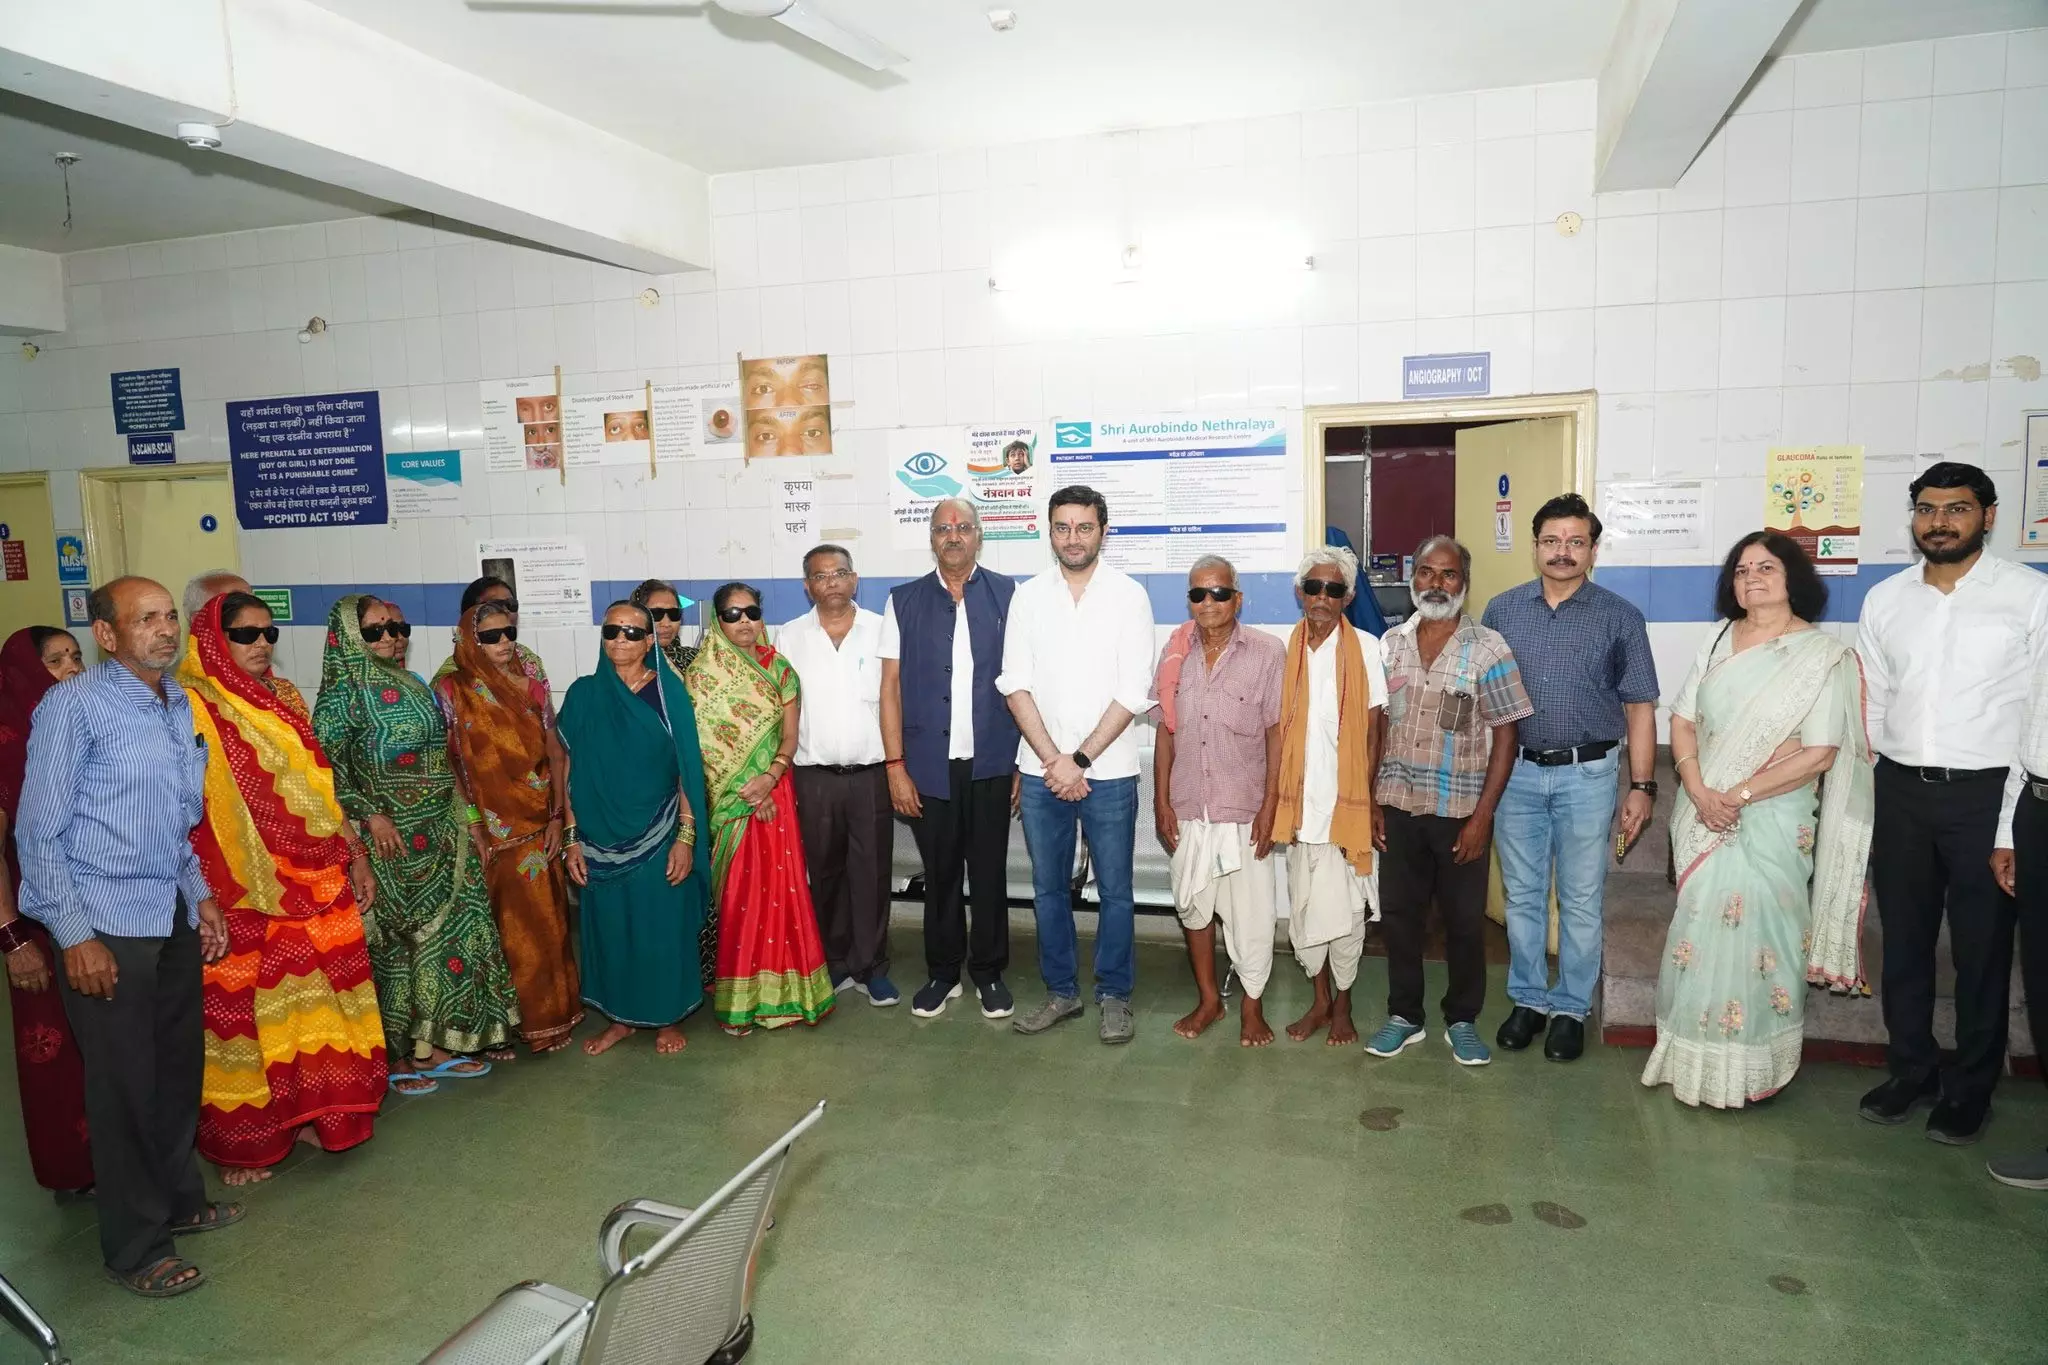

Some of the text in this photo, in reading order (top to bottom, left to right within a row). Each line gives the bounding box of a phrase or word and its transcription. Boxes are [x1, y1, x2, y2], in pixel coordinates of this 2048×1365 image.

[1408, 367, 1462, 385] ANGIOGRAPHY
[1467, 366, 1483, 383] OCT
[256, 405, 282, 416] गर्भस्थ
[283, 403, 303, 416] शिशु
[317, 401, 334, 411] लिंग
[335, 399, 364, 410] परीक्षण
[779, 411, 797, 419] AFTER
[241, 422, 267, 432] (लड़का
[268, 421, 278, 429] या
[280, 416, 306, 430] लड़की)
[324, 414, 344, 425] किया
[345, 414, 366, 424] जाता
[1100, 417, 1275, 436] Shri Aurobindo Nethralaya
[272, 434, 285, 444] एक
[286, 430, 312, 442] दंडनीय
[314, 430, 342, 440] अपराध
[240, 445, 373, 460] HERE PRENATAL SEX DETERMINATION
[1777, 454, 1815, 462] GLAUCOMA
[258, 456, 356, 471] (BOY OR GIRL) IS NOT DONE
[401, 459, 446, 469] CORE VALUES
[278, 472, 284, 480] A
[285, 469, 331, 479] PUNISHABLE
[784, 481, 812, 496] कृपया
[983, 485, 1033, 498] नेत्रदान करें
[1502, 480, 1506, 491] 3
[784, 502, 811, 512] मास्क
[206, 519, 211, 527] 4
[309, 512, 329, 522] ACT
[785, 519, 807, 533] पहनें
[60, 554, 89, 567] MASK
